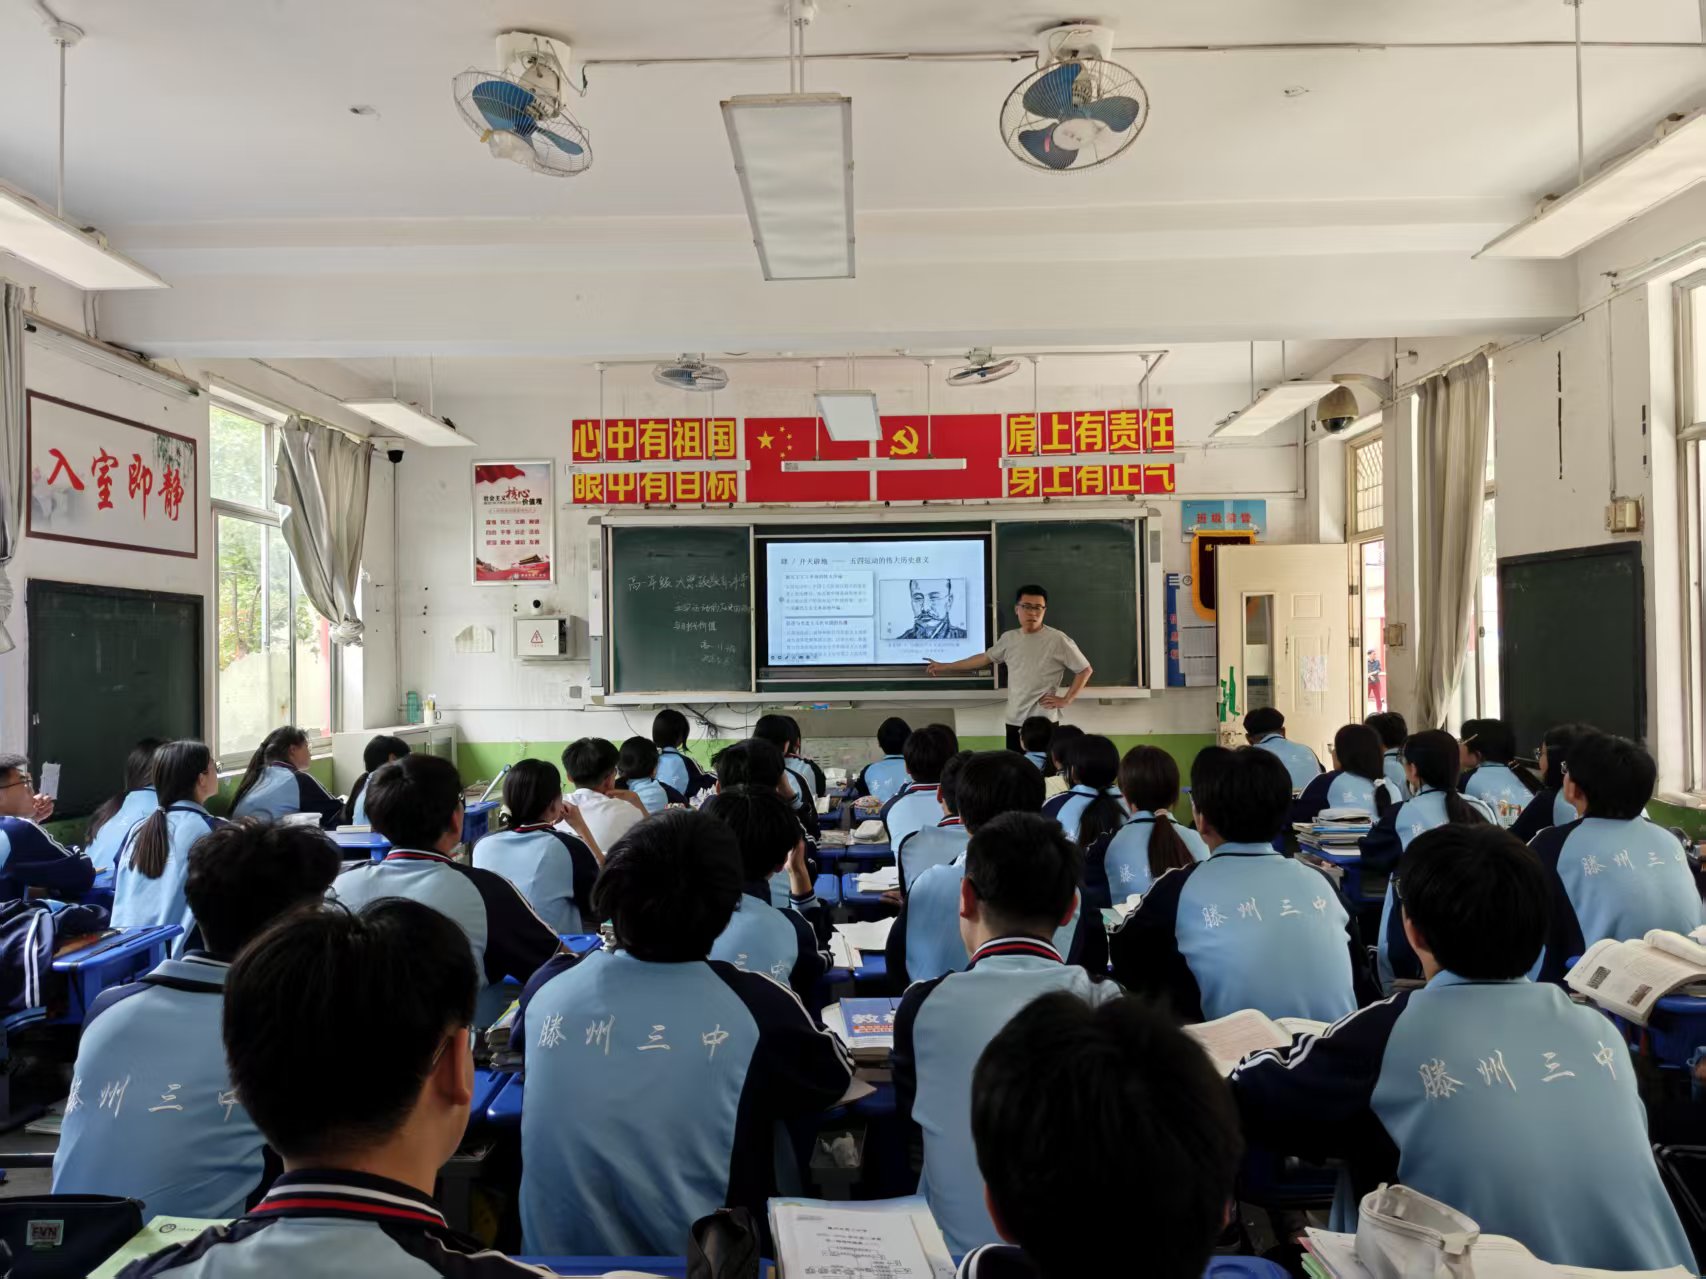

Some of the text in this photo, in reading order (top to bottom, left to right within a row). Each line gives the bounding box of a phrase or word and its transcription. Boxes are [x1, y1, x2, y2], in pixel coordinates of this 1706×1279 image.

[573, 420, 736, 458] 心中有祖国
[1008, 411, 1174, 453] 肩上有责任
[47, 447, 185, 521] 入室即静
[574, 471, 737, 501] 眼中有目标
[1009, 463, 1174, 495] 身上有正气
[1202, 896, 1328, 929] 滕州三中
[537, 1011, 730, 1058] 滕州三中
[1418, 1040, 1617, 1099] 滕州三中
